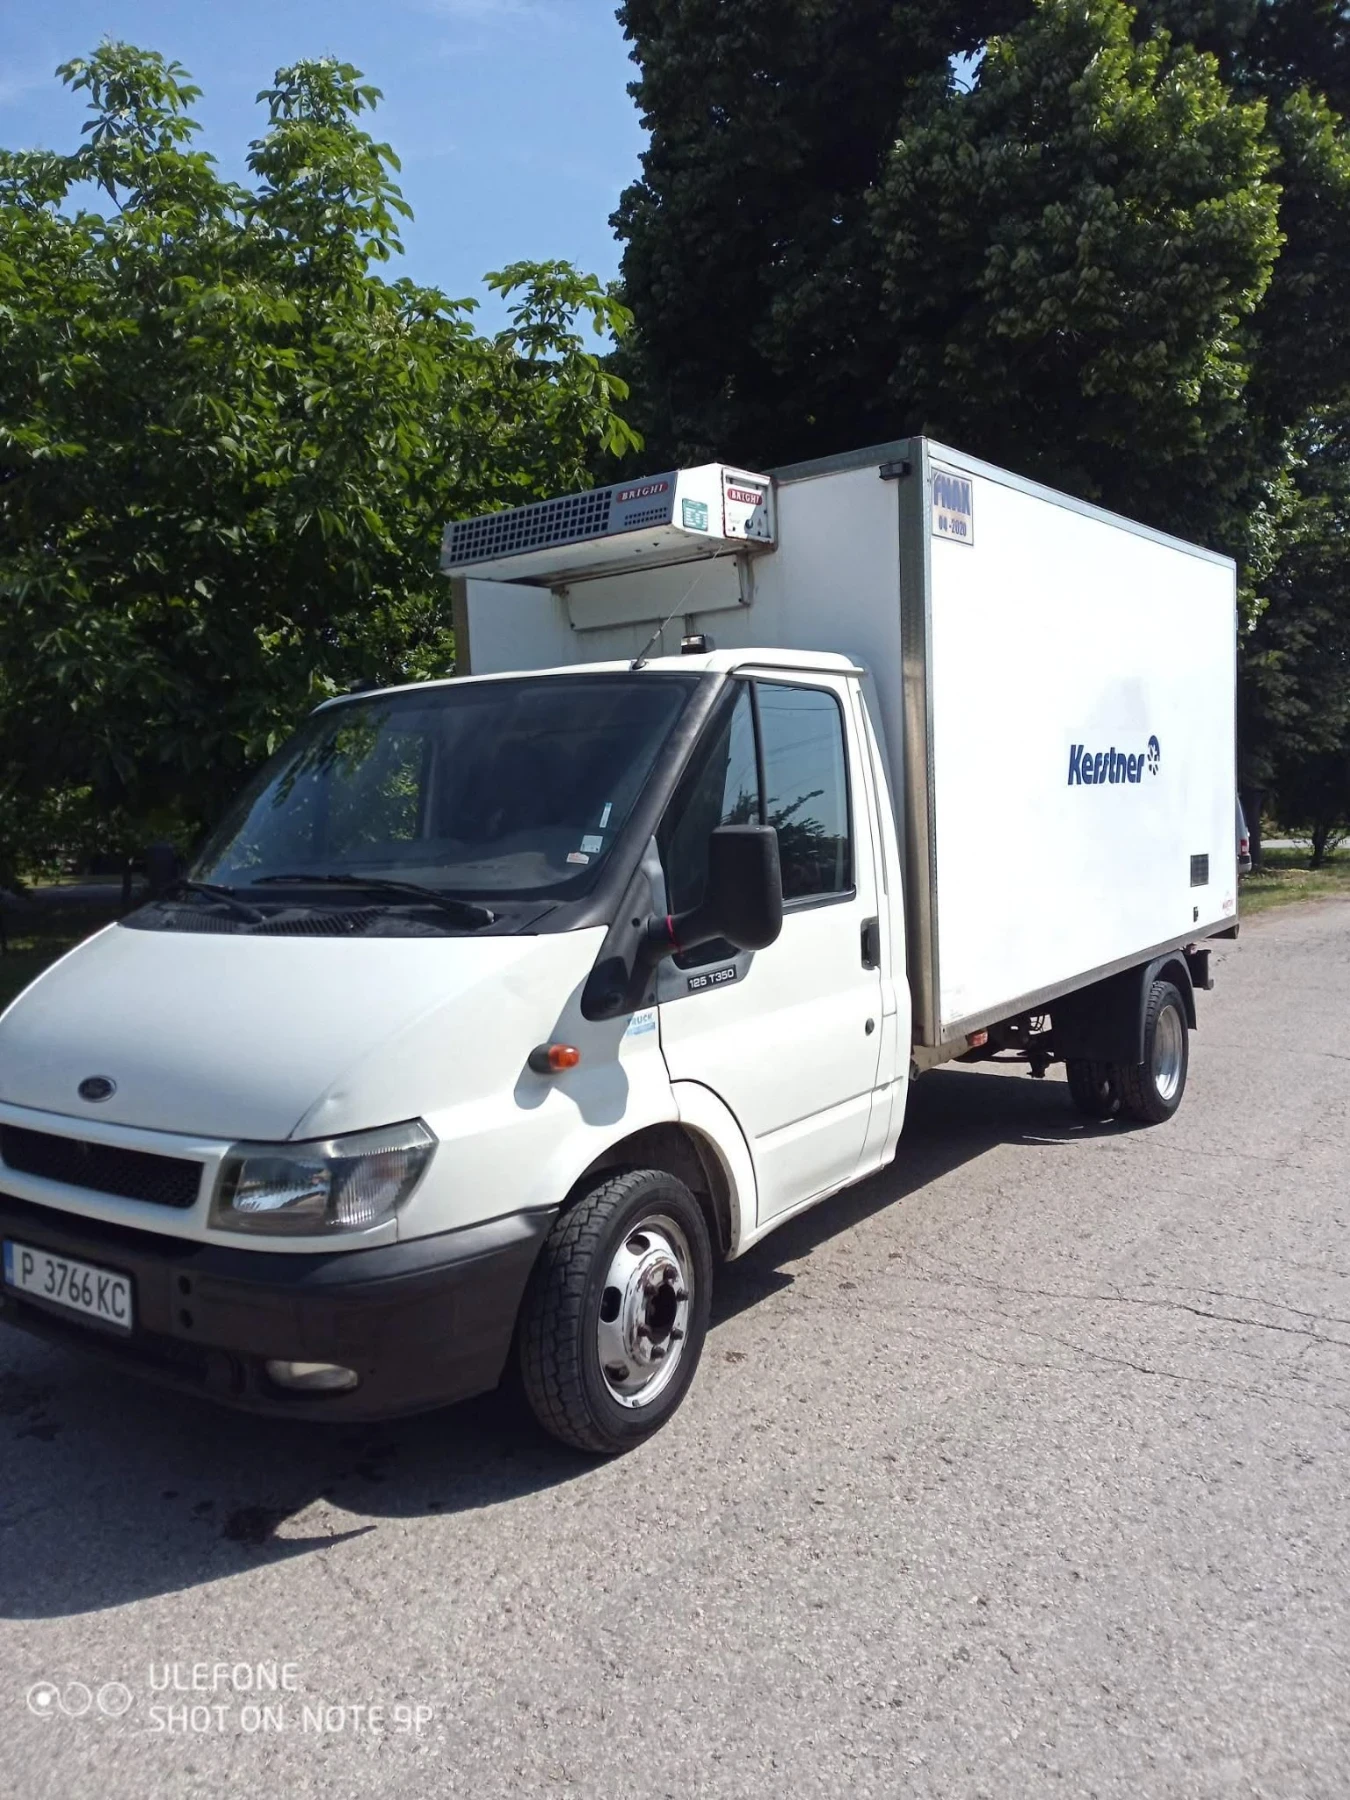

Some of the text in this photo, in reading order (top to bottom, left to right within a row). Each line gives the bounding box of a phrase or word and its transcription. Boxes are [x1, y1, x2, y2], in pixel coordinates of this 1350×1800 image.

[1067, 744, 1145, 785] Kerstner
[689, 968, 735, 989] 125 T350
[22, 1251, 34, 1285] P
